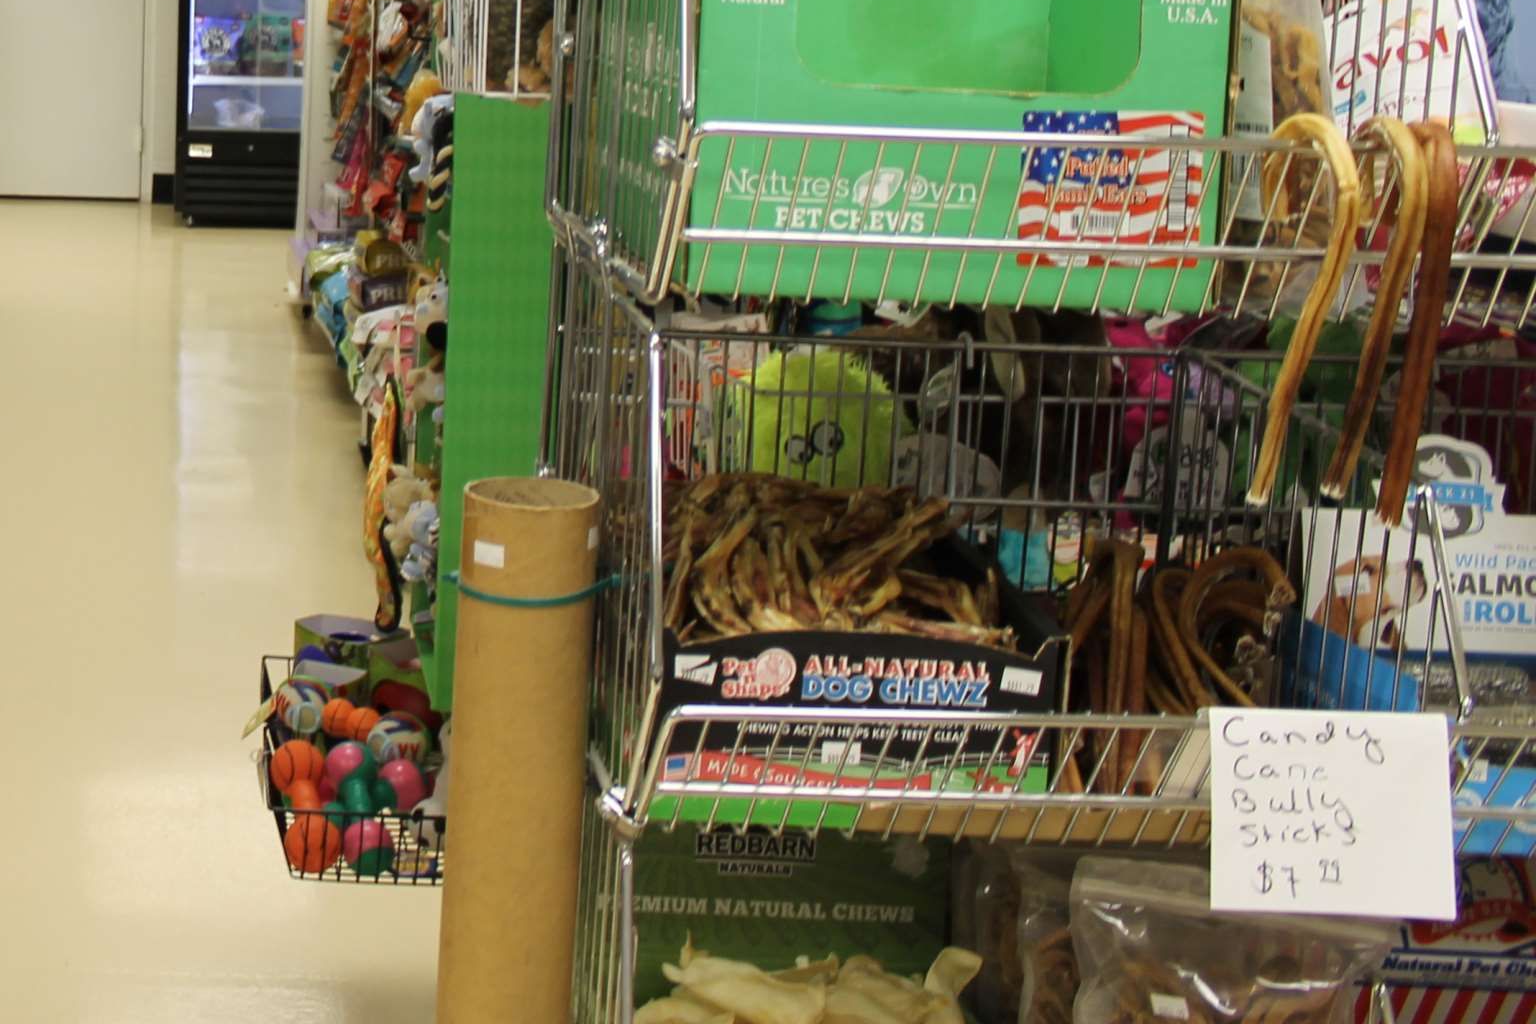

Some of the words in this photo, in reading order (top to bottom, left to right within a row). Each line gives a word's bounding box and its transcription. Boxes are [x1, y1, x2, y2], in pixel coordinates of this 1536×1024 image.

[1166, 7, 1219, 26] U.S.A.
[724, 167, 850, 198] Nature's
[775, 205, 822, 229] PET
[828, 208, 925, 233] CHEWS
[1455, 553, 1498, 570] Wild
[803, 654, 991, 680] ALL-NATURAL
[800, 675, 873, 703] DOG
[879, 676, 991, 707] CHEWZ
[792, 724, 835, 738] ACTON
[836, 725, 870, 739] HEPS
[1222, 715, 1386, 765] Candy
[1231, 787, 1354, 828] Bully
[695, 832, 816, 858] REDBARN
[1239, 819, 1357, 848] Sticks
[713, 897, 828, 921] NATURAL
[831, 902, 916, 923] CHEWS
[1381, 953, 1464, 972] Natural
[1467, 959, 1502, 975] Pet
